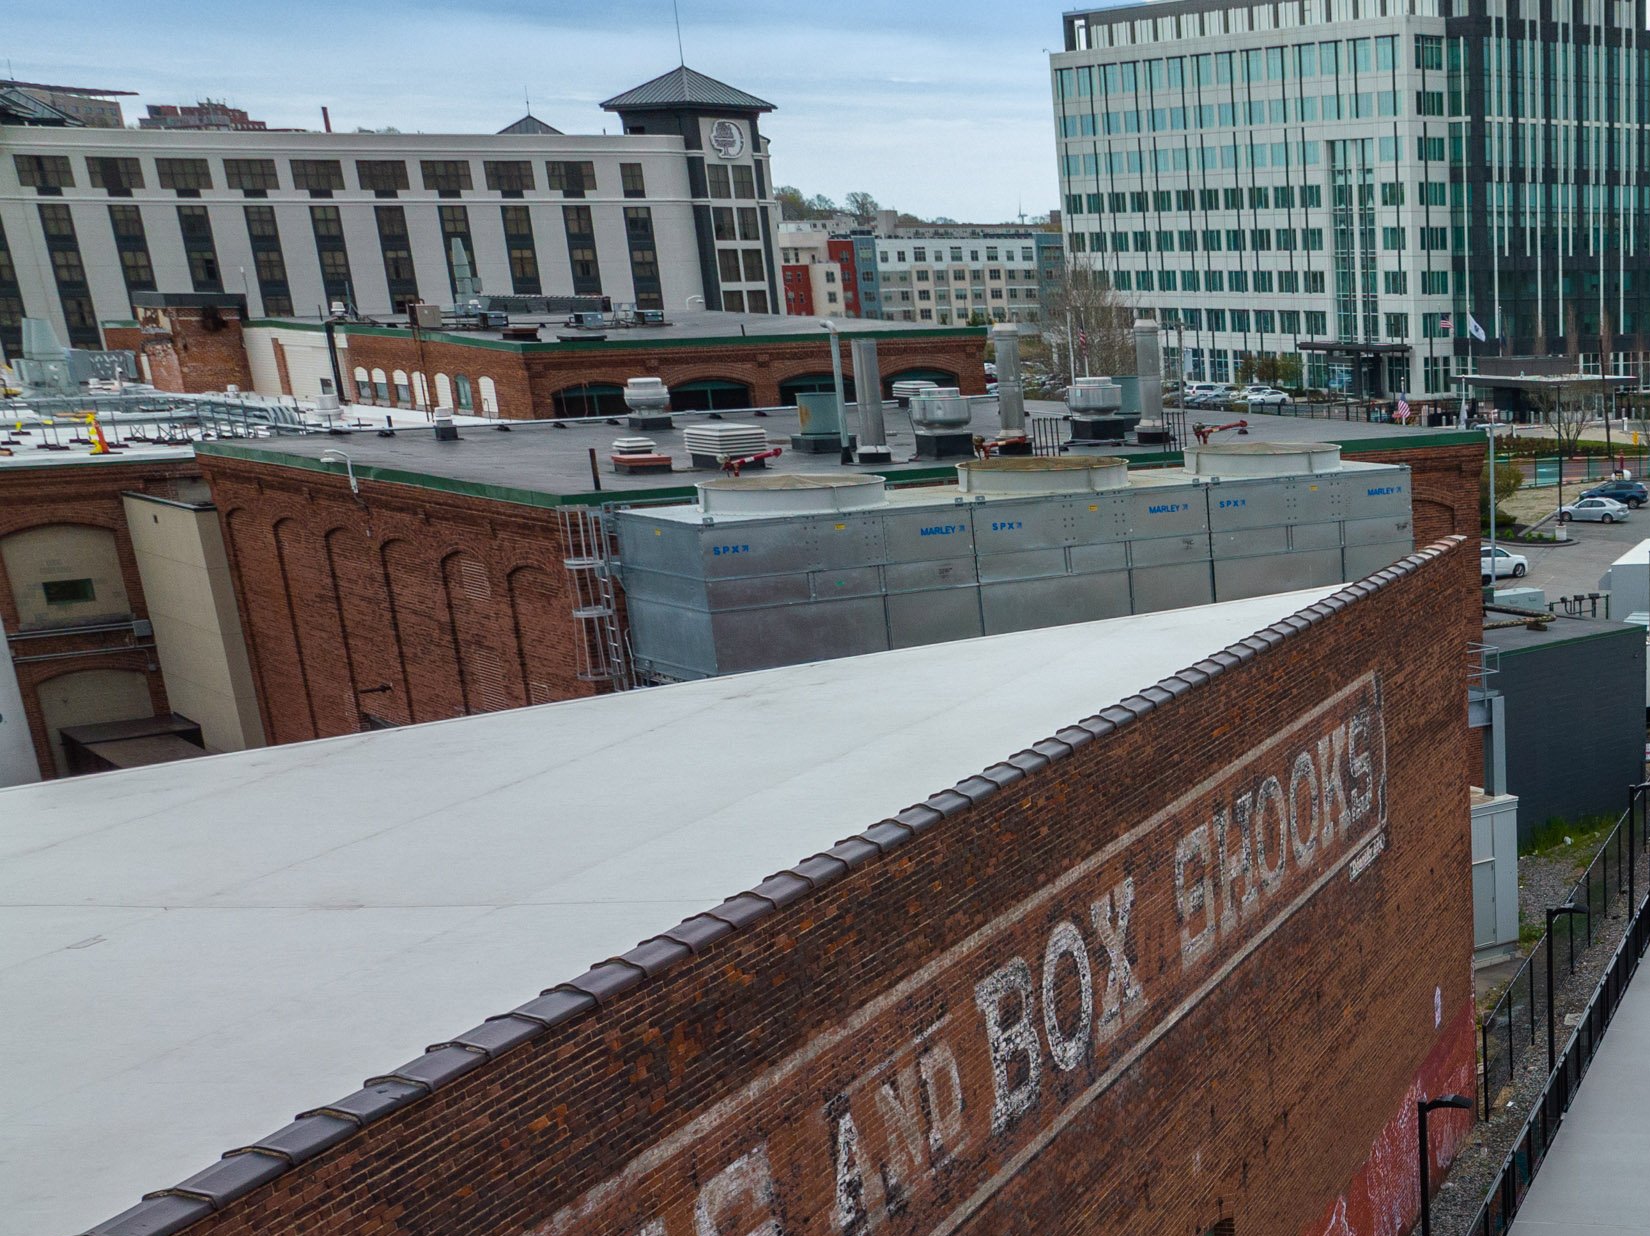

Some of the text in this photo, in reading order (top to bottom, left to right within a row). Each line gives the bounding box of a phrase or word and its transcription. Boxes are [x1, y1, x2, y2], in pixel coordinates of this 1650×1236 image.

[1367, 487, 1394, 496] MARLEY
[1148, 504, 1180, 514] MARLEY
[1219, 499, 1239, 509] SPX
[920, 525, 956, 536] MARLEY
[992, 522, 1015, 531] SPX
[713, 545, 740, 556] SPX
[974, 876, 1150, 1136] BOX
[1174, 710, 1374, 972] SHOOKS
